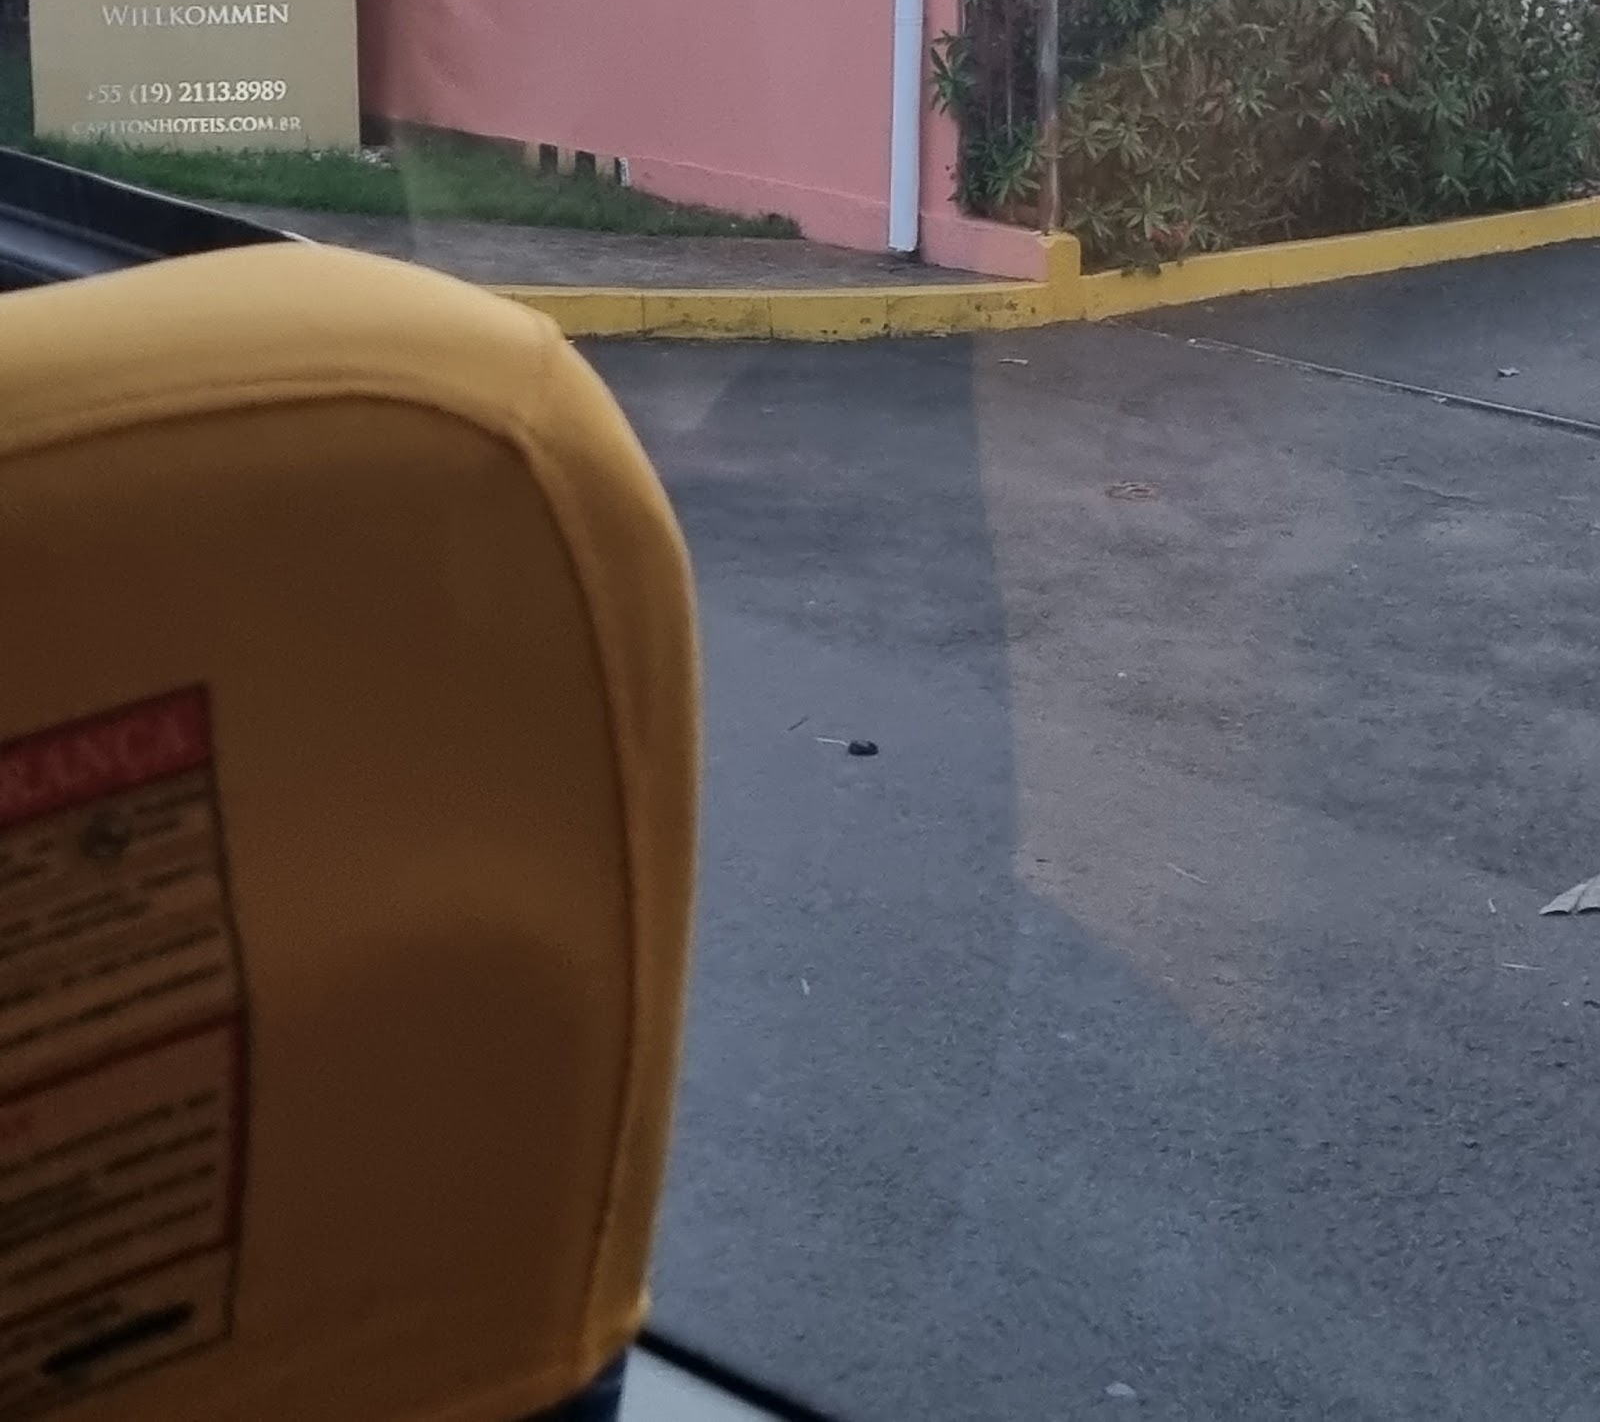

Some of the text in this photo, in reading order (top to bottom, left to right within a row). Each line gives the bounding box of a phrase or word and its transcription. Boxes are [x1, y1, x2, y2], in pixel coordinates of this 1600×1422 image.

[102, 3, 289, 27] WILLKOMMEN
[129, 82, 172, 104] (19)
[178, 80, 287, 103] 2113.8989
